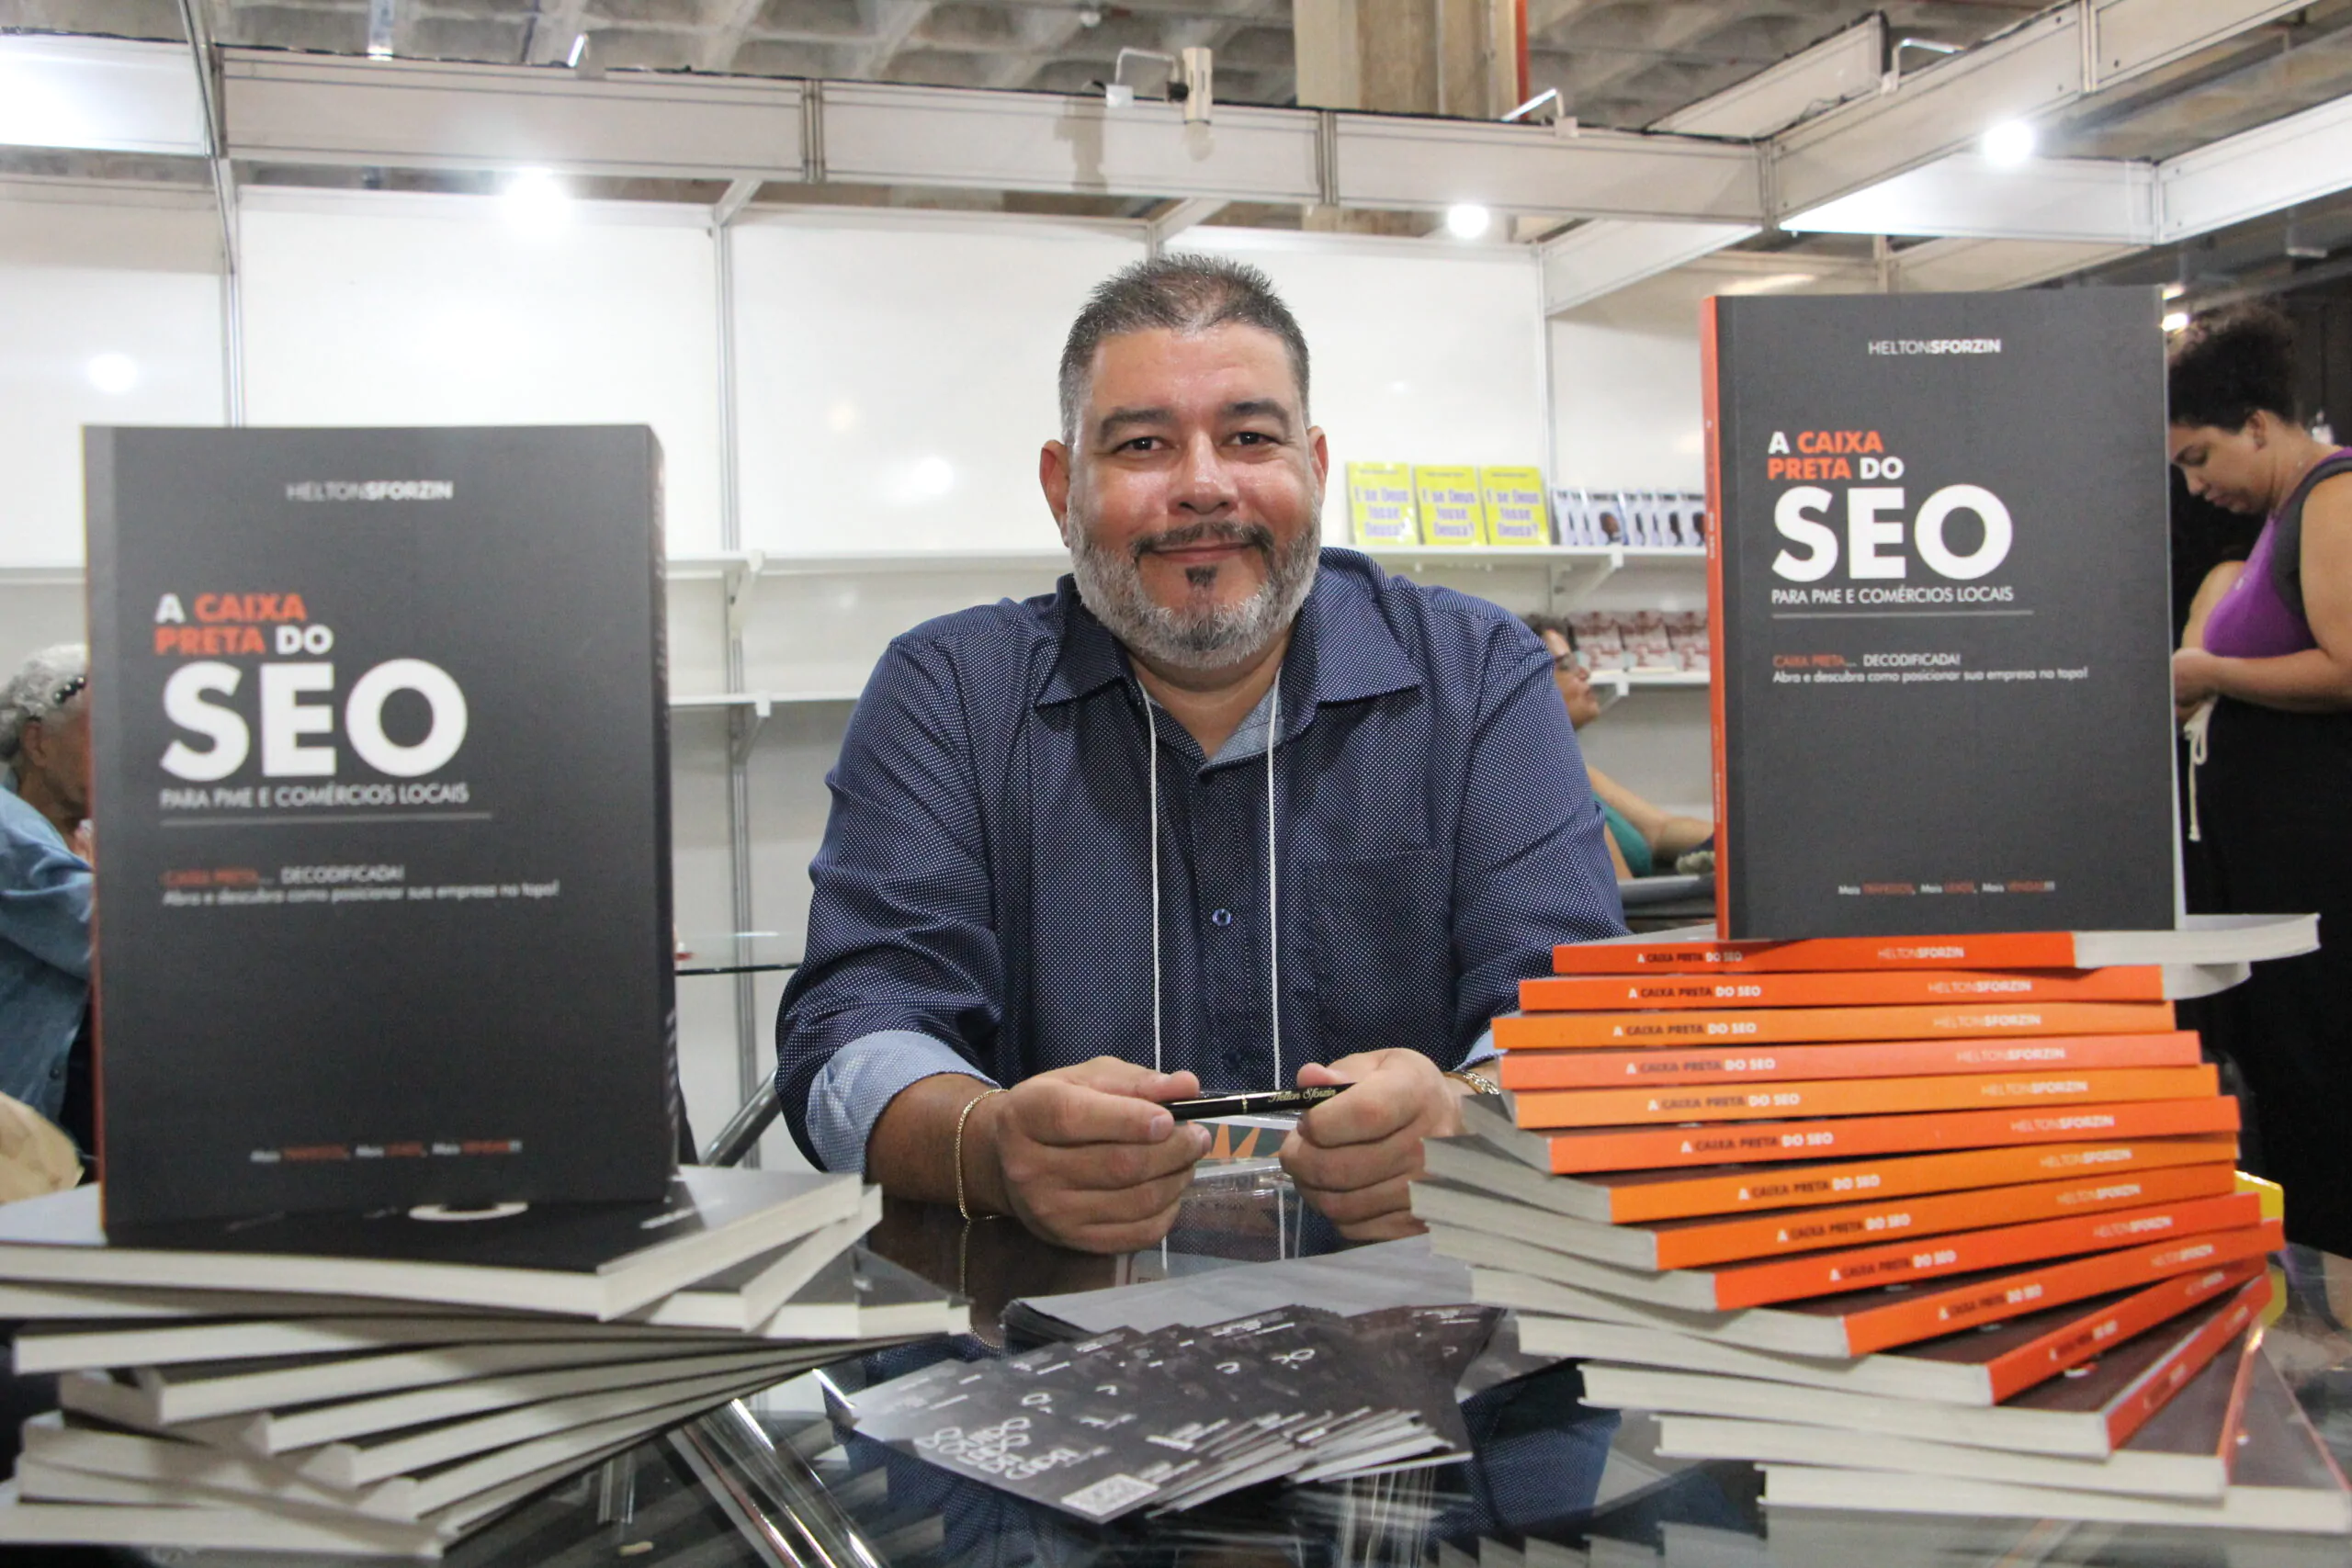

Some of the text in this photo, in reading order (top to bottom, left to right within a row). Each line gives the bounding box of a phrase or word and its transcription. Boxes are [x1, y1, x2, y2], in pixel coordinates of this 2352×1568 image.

[1869, 339, 2001, 355] HELTONSFORZIN
[1769, 431, 1883, 454] A CAIXA
[1768, 457, 1905, 479] PRETA DO
[286, 480, 453, 502] HELTONSFORZIN
[1771, 483, 2013, 582] SEO
[1771, 583, 2013, 604] PARA PME E COMÉRCIOS LOCAIS
[155, 593, 307, 623] A CAIXA
[153, 625, 334, 655] PRETA DO
[1863, 653, 1960, 667] DECODIFICADA!
[1772, 671, 1801, 683] Abra
[1804, 673, 1811, 682] e
[1814, 670, 1865, 683] descubra
[1867, 672, 1899, 682] como
[1902, 670, 1961, 684] posicionar
[1963, 671, 1984, 682] sua
[159, 658, 468, 782] SEO
[160, 788, 209, 810] PARA
[258, 787, 270, 807] E
[275, 781, 395, 807] COMÉRCIOS
[400, 782, 469, 805] LOCAIS
[1637, 953, 1645, 963] A
[1706, 952, 1721, 962] DO
[1724, 952, 1742, 962] SEO
[1629, 988, 1638, 998] A
[1715, 987, 1735, 998] DO
[1737, 986, 1761, 997] SEO
[1613, 1026, 1623, 1036] A
[1708, 1023, 1728, 1034] DO
[1731, 1022, 1757, 1033] SEO
[1626, 1063, 1636, 1075] A
[1724, 1059, 1747, 1071] DO
[1749, 1058, 1776, 1070] SEO
[1647, 1100, 1658, 1111] A
[1748, 1095, 1770, 1107] DO
[1773, 1093, 1801, 1106] SEO
[1680, 1141, 1692, 1153] A
[1781, 1135, 1804, 1147] DO
[1806, 1133, 1834, 1145] SEO
